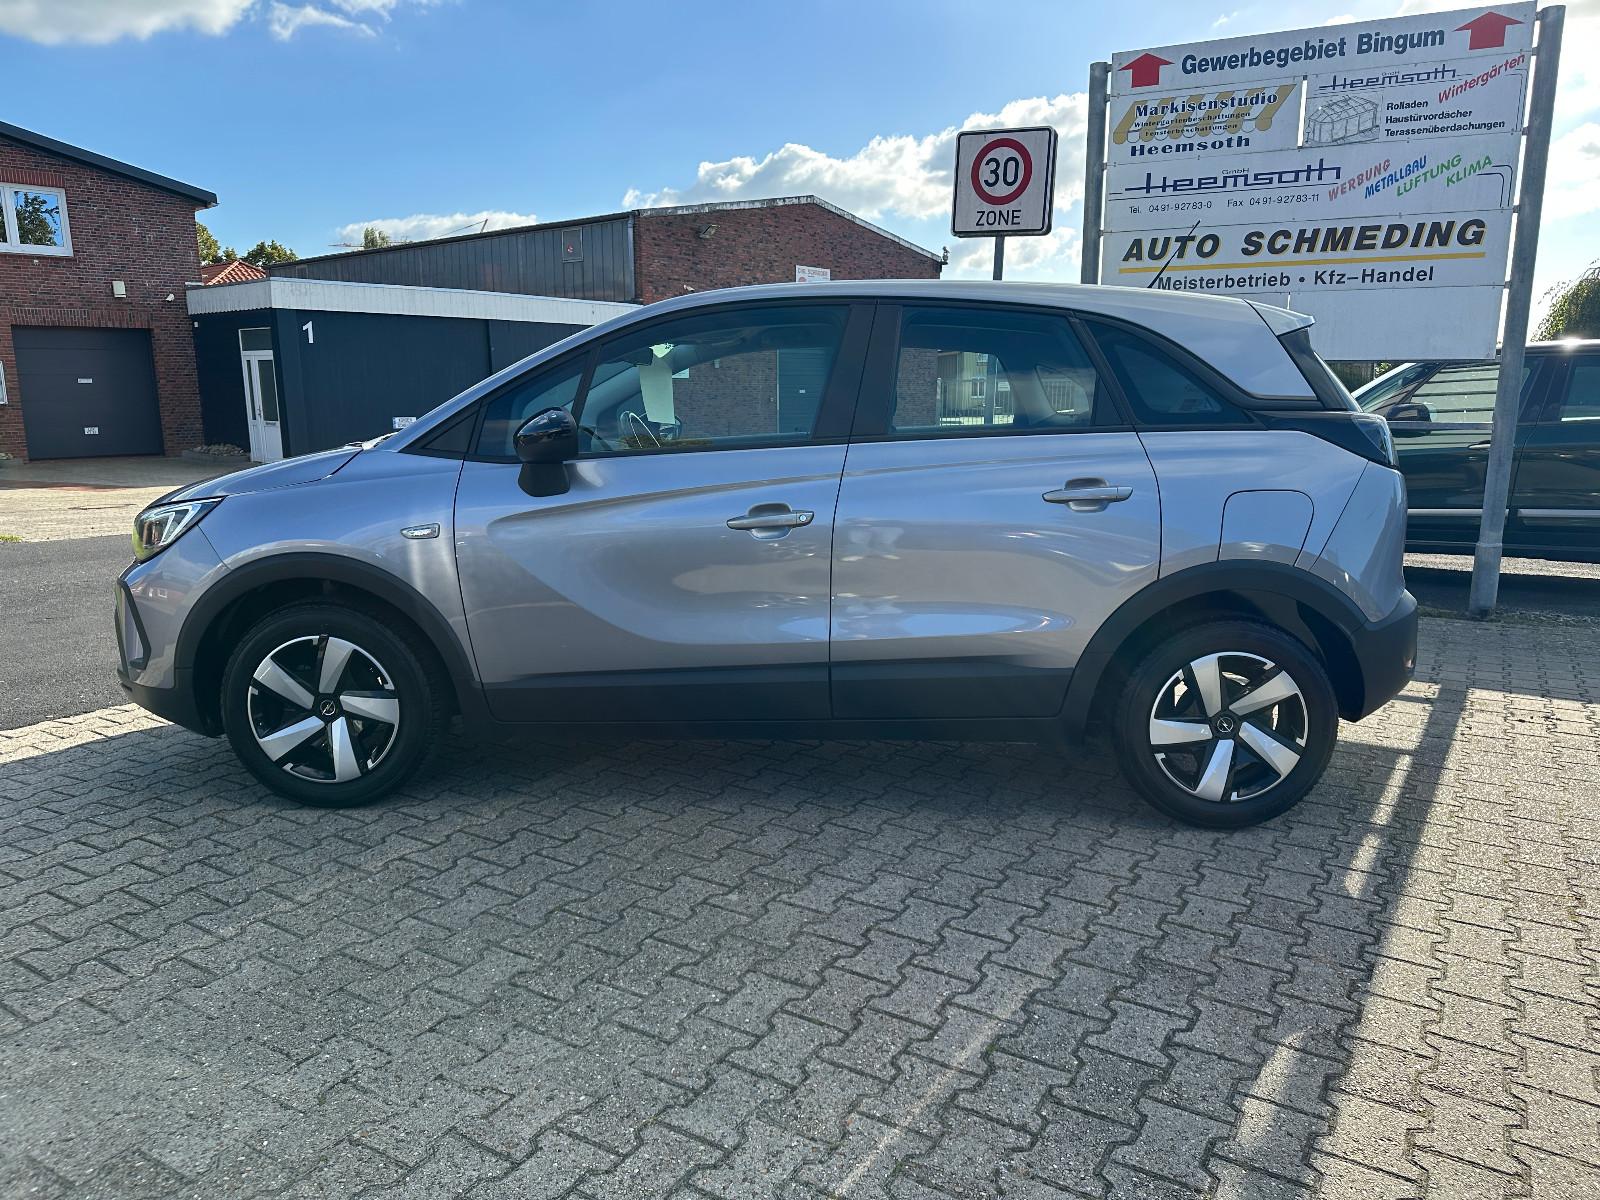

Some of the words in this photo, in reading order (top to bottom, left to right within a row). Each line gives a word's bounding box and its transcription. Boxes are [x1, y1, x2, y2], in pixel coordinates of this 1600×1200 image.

[1182, 38, 1346, 75] Gewerbegebiet
[1356, 29, 1445, 56] Bingum
[1319, 63, 1456, 90] Heemsoth
[1438, 54, 1526, 104] Wintergärten
[1135, 92, 1278, 117] Markisenstudio
[1385, 109, 1473, 125] Haustürvordächer
[1386, 100, 1429, 112] Rolladen
[1384, 120, 1506, 138] Terassenüberdachungen
[1130, 135, 1250, 157] Heemsoth
[984, 157, 1019, 187] 30
[1124, 158, 1342, 195] Heemsoth
[1221, 167, 1250, 176] GmbH
[1328, 159, 1391, 202] WERBUNG
[1364, 155, 1428, 200] METALLBAU
[1446, 155, 1494, 188] KLIMA
[1129, 206, 1142, 215] Tel.
[1148, 200, 1213, 214] 0491-92783-0
[1227, 198, 1245, 209] Fax
[1249, 193, 1320, 207] 0491-92783-11
[976, 210, 1021, 226] ZONE
[1121, 233, 1221, 263] AUTO
[1241, 218, 1487, 257] SCHMEDING
[1157, 273, 1291, 291] Meisterbetrieb
[1313, 266, 1434, 286] Kfz-Handel
[302, 321, 314, 344] 1
